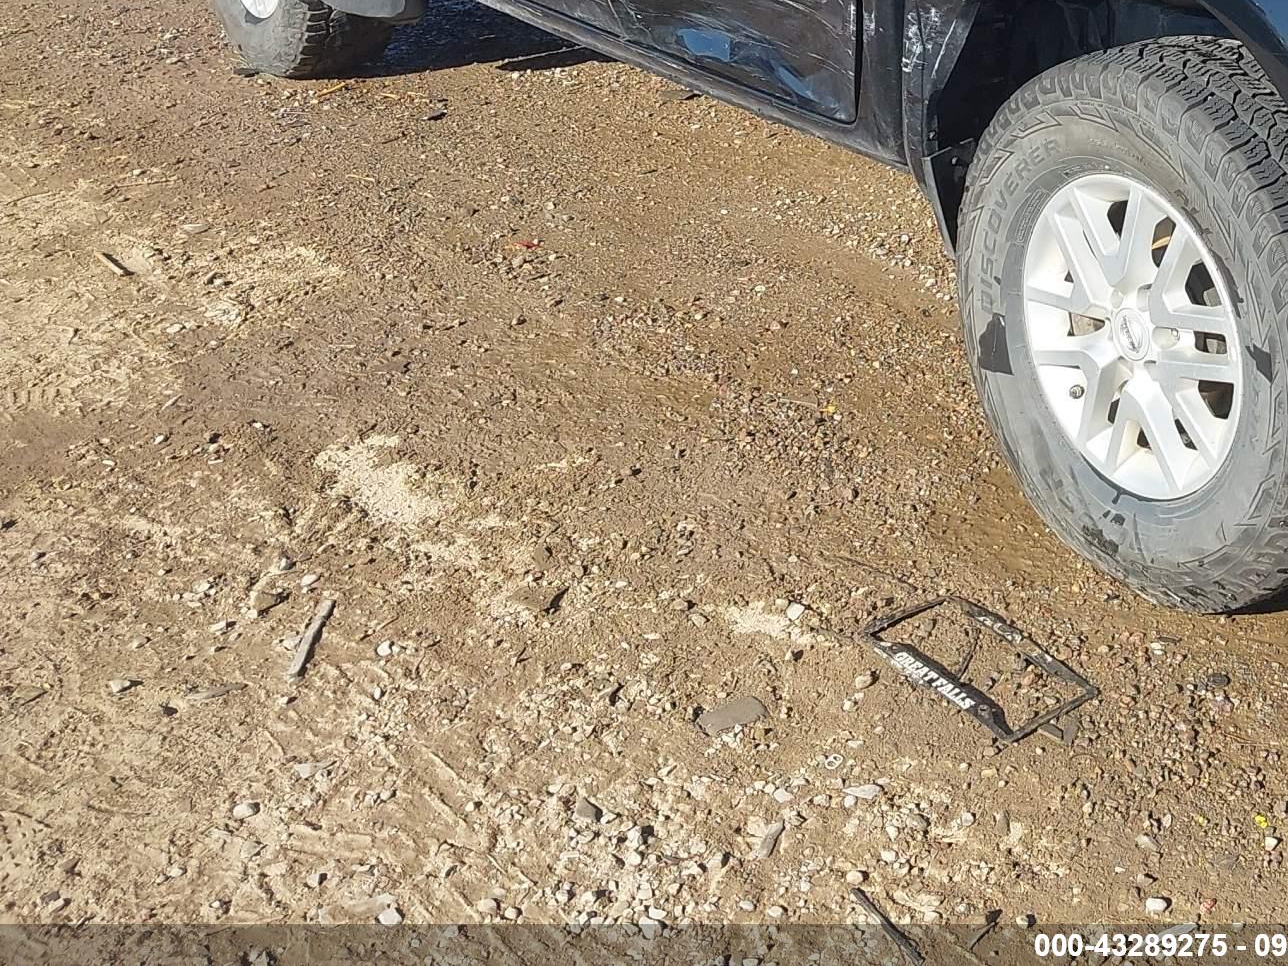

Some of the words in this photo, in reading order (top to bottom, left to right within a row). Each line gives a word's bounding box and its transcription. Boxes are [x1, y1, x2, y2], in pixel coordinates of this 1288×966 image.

[980, 137, 1059, 315] DISCOVERER
[893, 652, 939, 684] GREAT
[931, 677, 976, 710] FALLS
